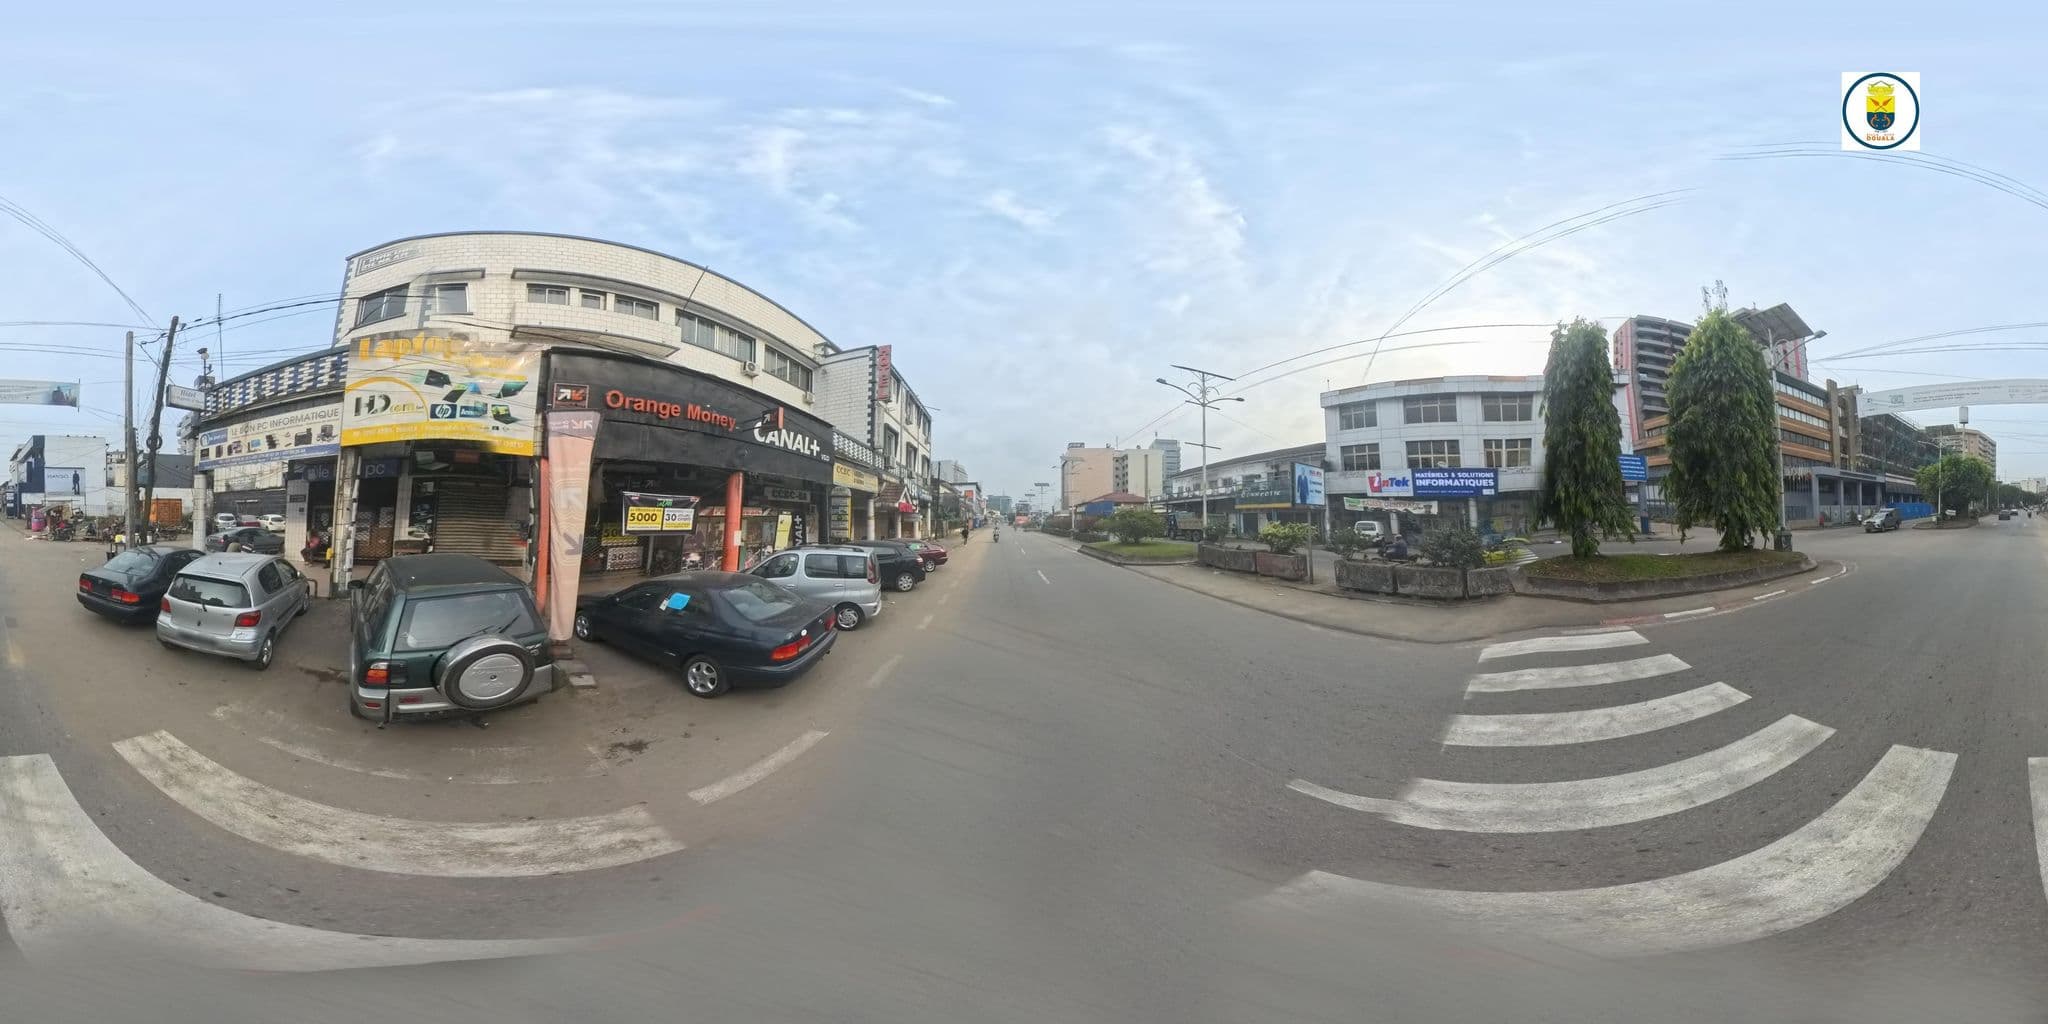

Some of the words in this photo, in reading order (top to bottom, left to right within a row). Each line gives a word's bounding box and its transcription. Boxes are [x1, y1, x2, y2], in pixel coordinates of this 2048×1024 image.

[606, 390, 681, 418] Orange
[687, 403, 737, 432] Money
[231, 427, 239, 436] LE
[257, 420, 267, 430] PC
[269, 408, 340, 428] INFORMATIQUE
[753, 420, 821, 456] CANAL+
[364, 463, 385, 479] pc
[1415, 470, 1449, 478] MATÉRIELS
[1416, 479, 1495, 487] INFORMATIQUES
[629, 512, 658, 522] 5000
[665, 513, 677, 522] 30
